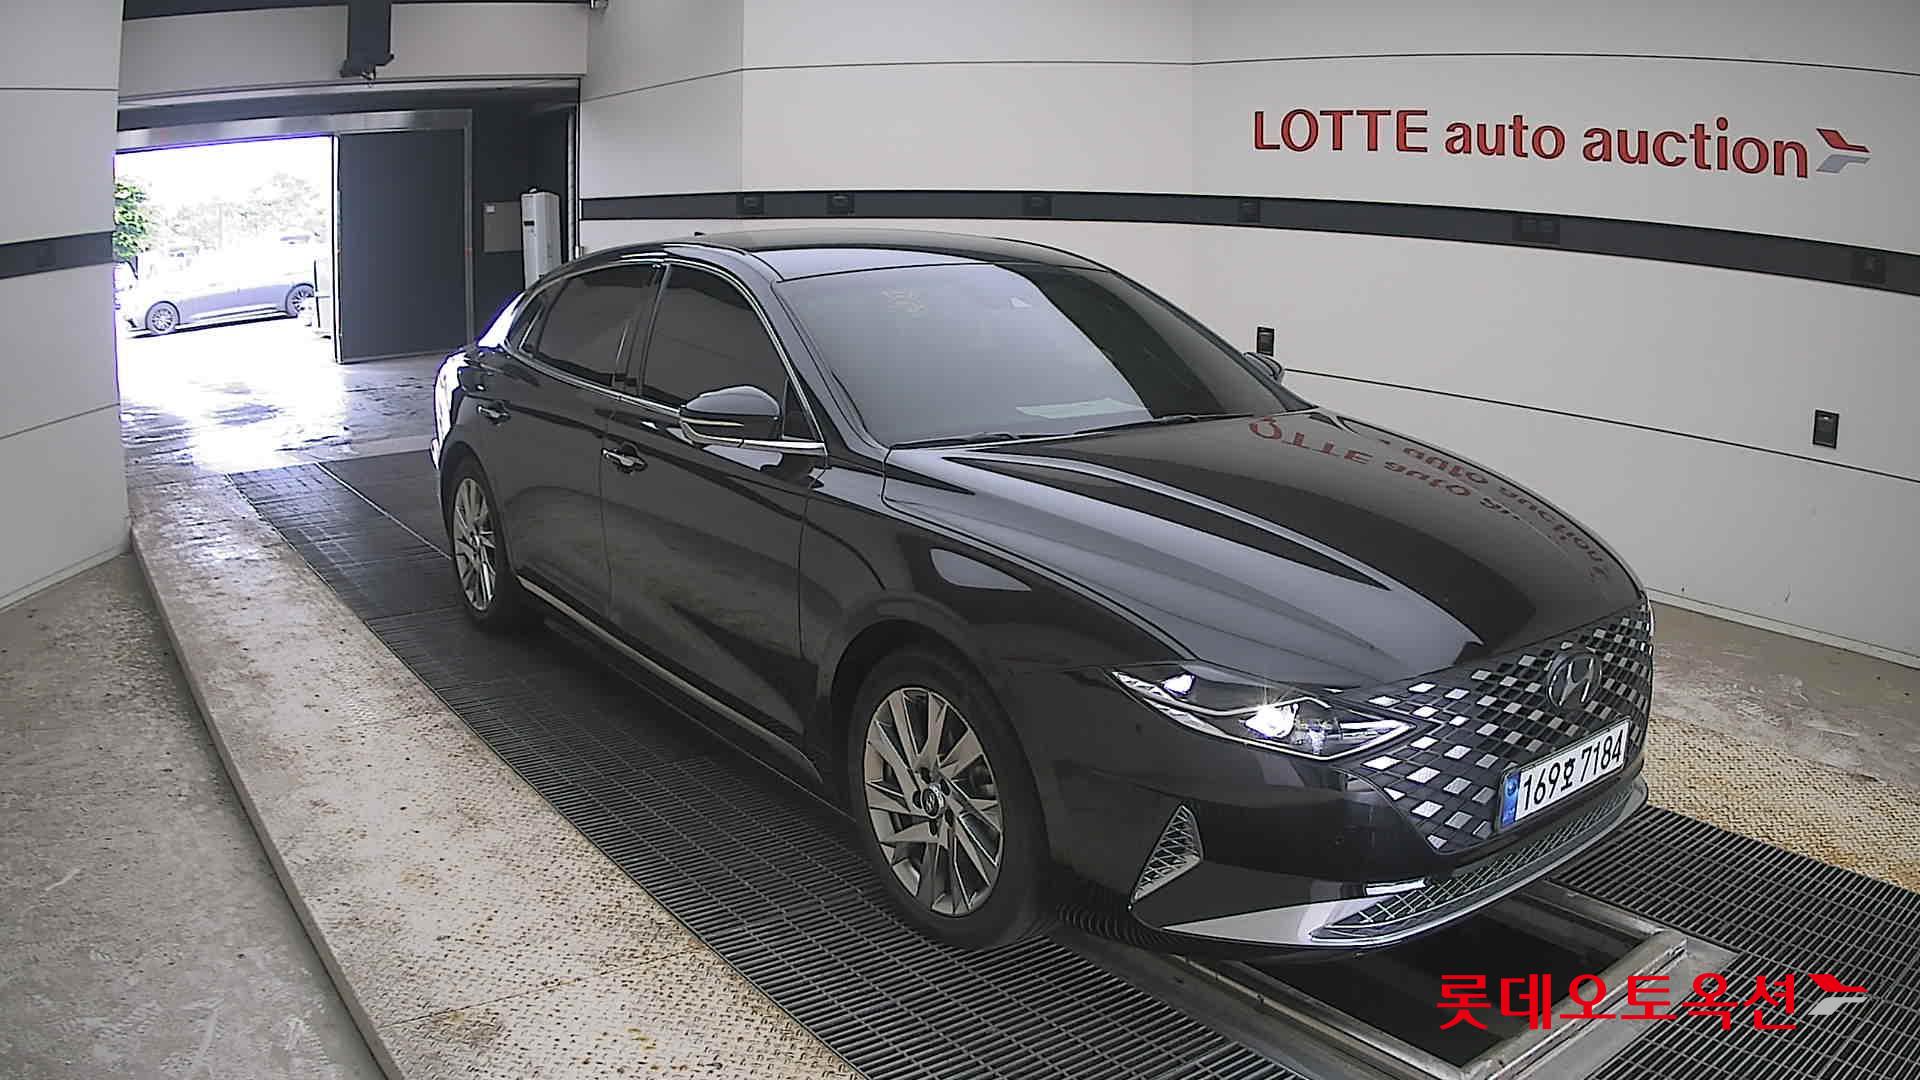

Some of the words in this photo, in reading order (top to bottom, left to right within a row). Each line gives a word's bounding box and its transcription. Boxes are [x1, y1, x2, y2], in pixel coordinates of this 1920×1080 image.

[1253, 108, 1428, 154] LOTTE
[1445, 114, 1567, 160] auto
[1582, 115, 1809, 179] auction
[1522, 757, 1576, 811] 169호
[1580, 729, 1625, 782] 7184
